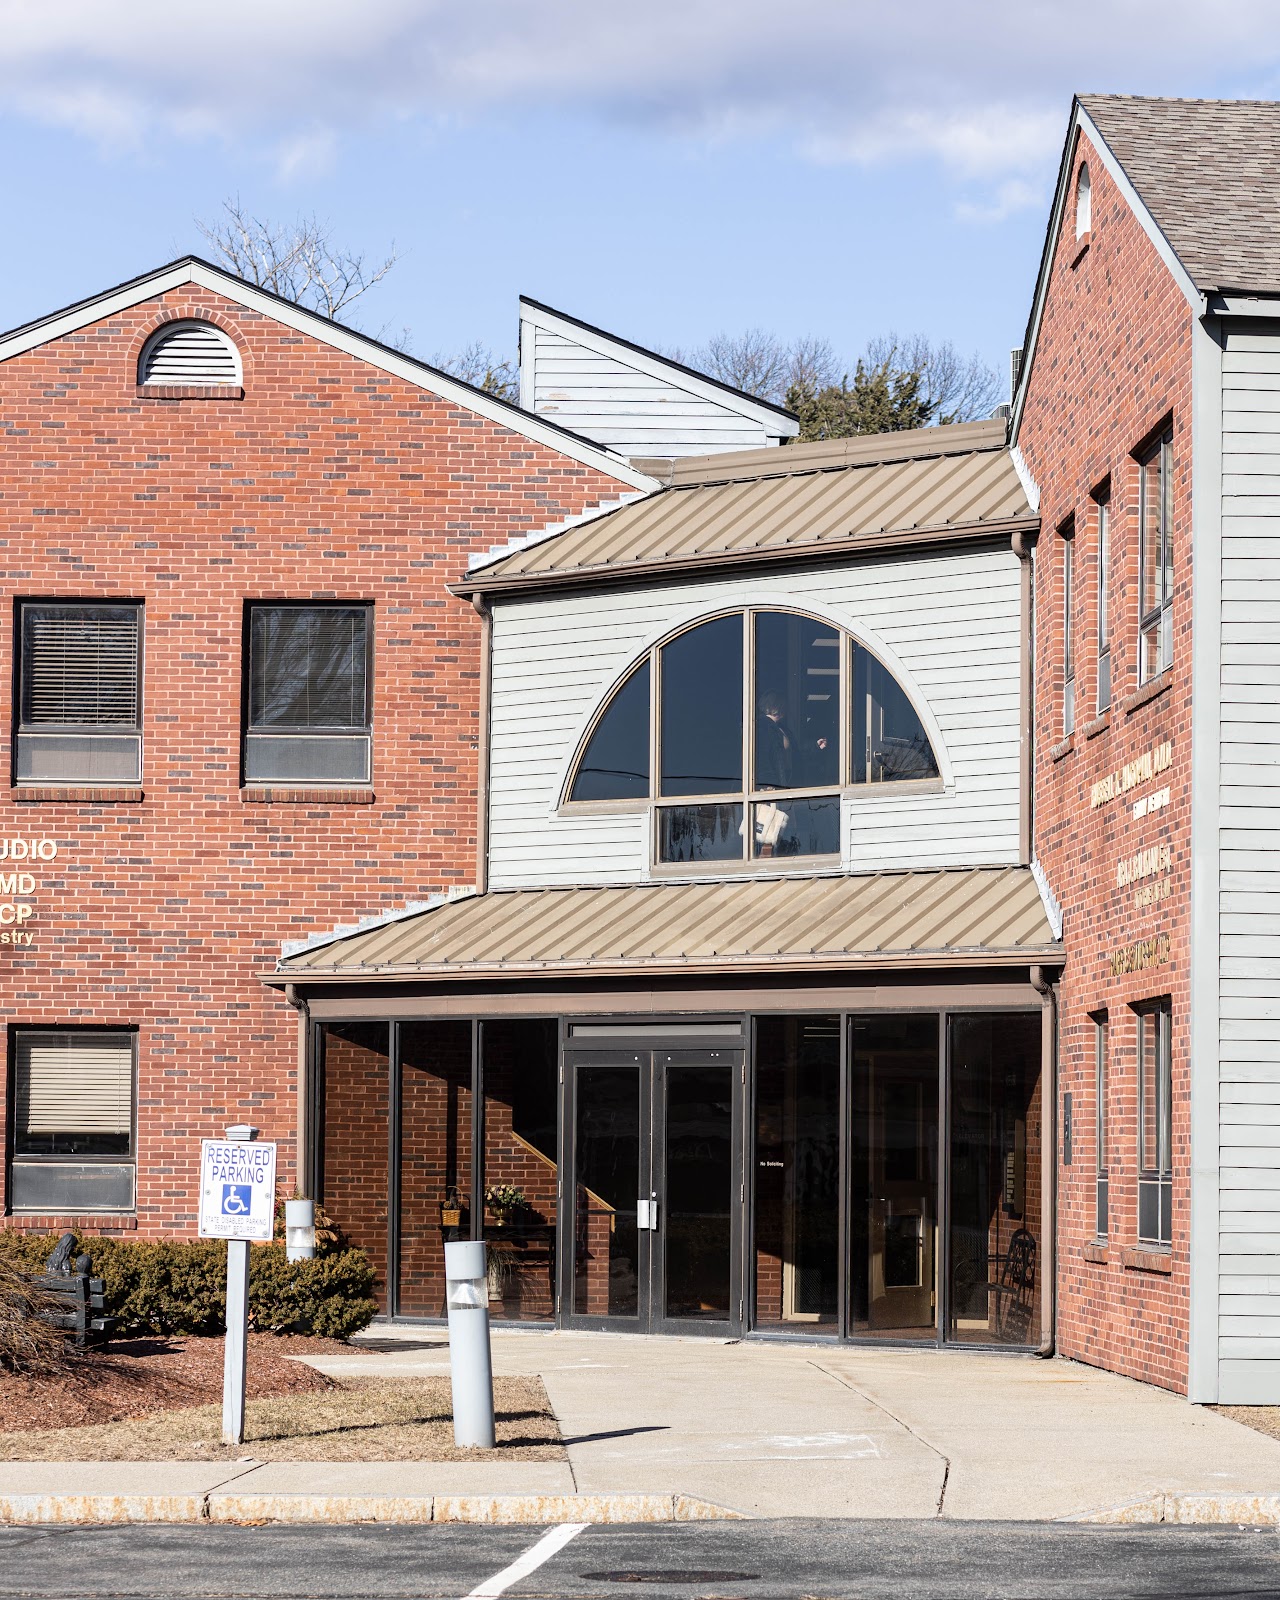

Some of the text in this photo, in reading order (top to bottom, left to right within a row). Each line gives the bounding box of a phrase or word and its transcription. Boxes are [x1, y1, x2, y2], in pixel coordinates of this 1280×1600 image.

[0, 873, 36, 894] MD
[0, 904, 33, 925] CP
[0, 929, 34, 946] stry
[208, 1148, 270, 1165] RESERVED
[212, 1166, 264, 1183] PARKING
[205, 1215, 267, 1226] STATE DISABLED PARKING
[215, 1224, 231, 1232] PERMIT
